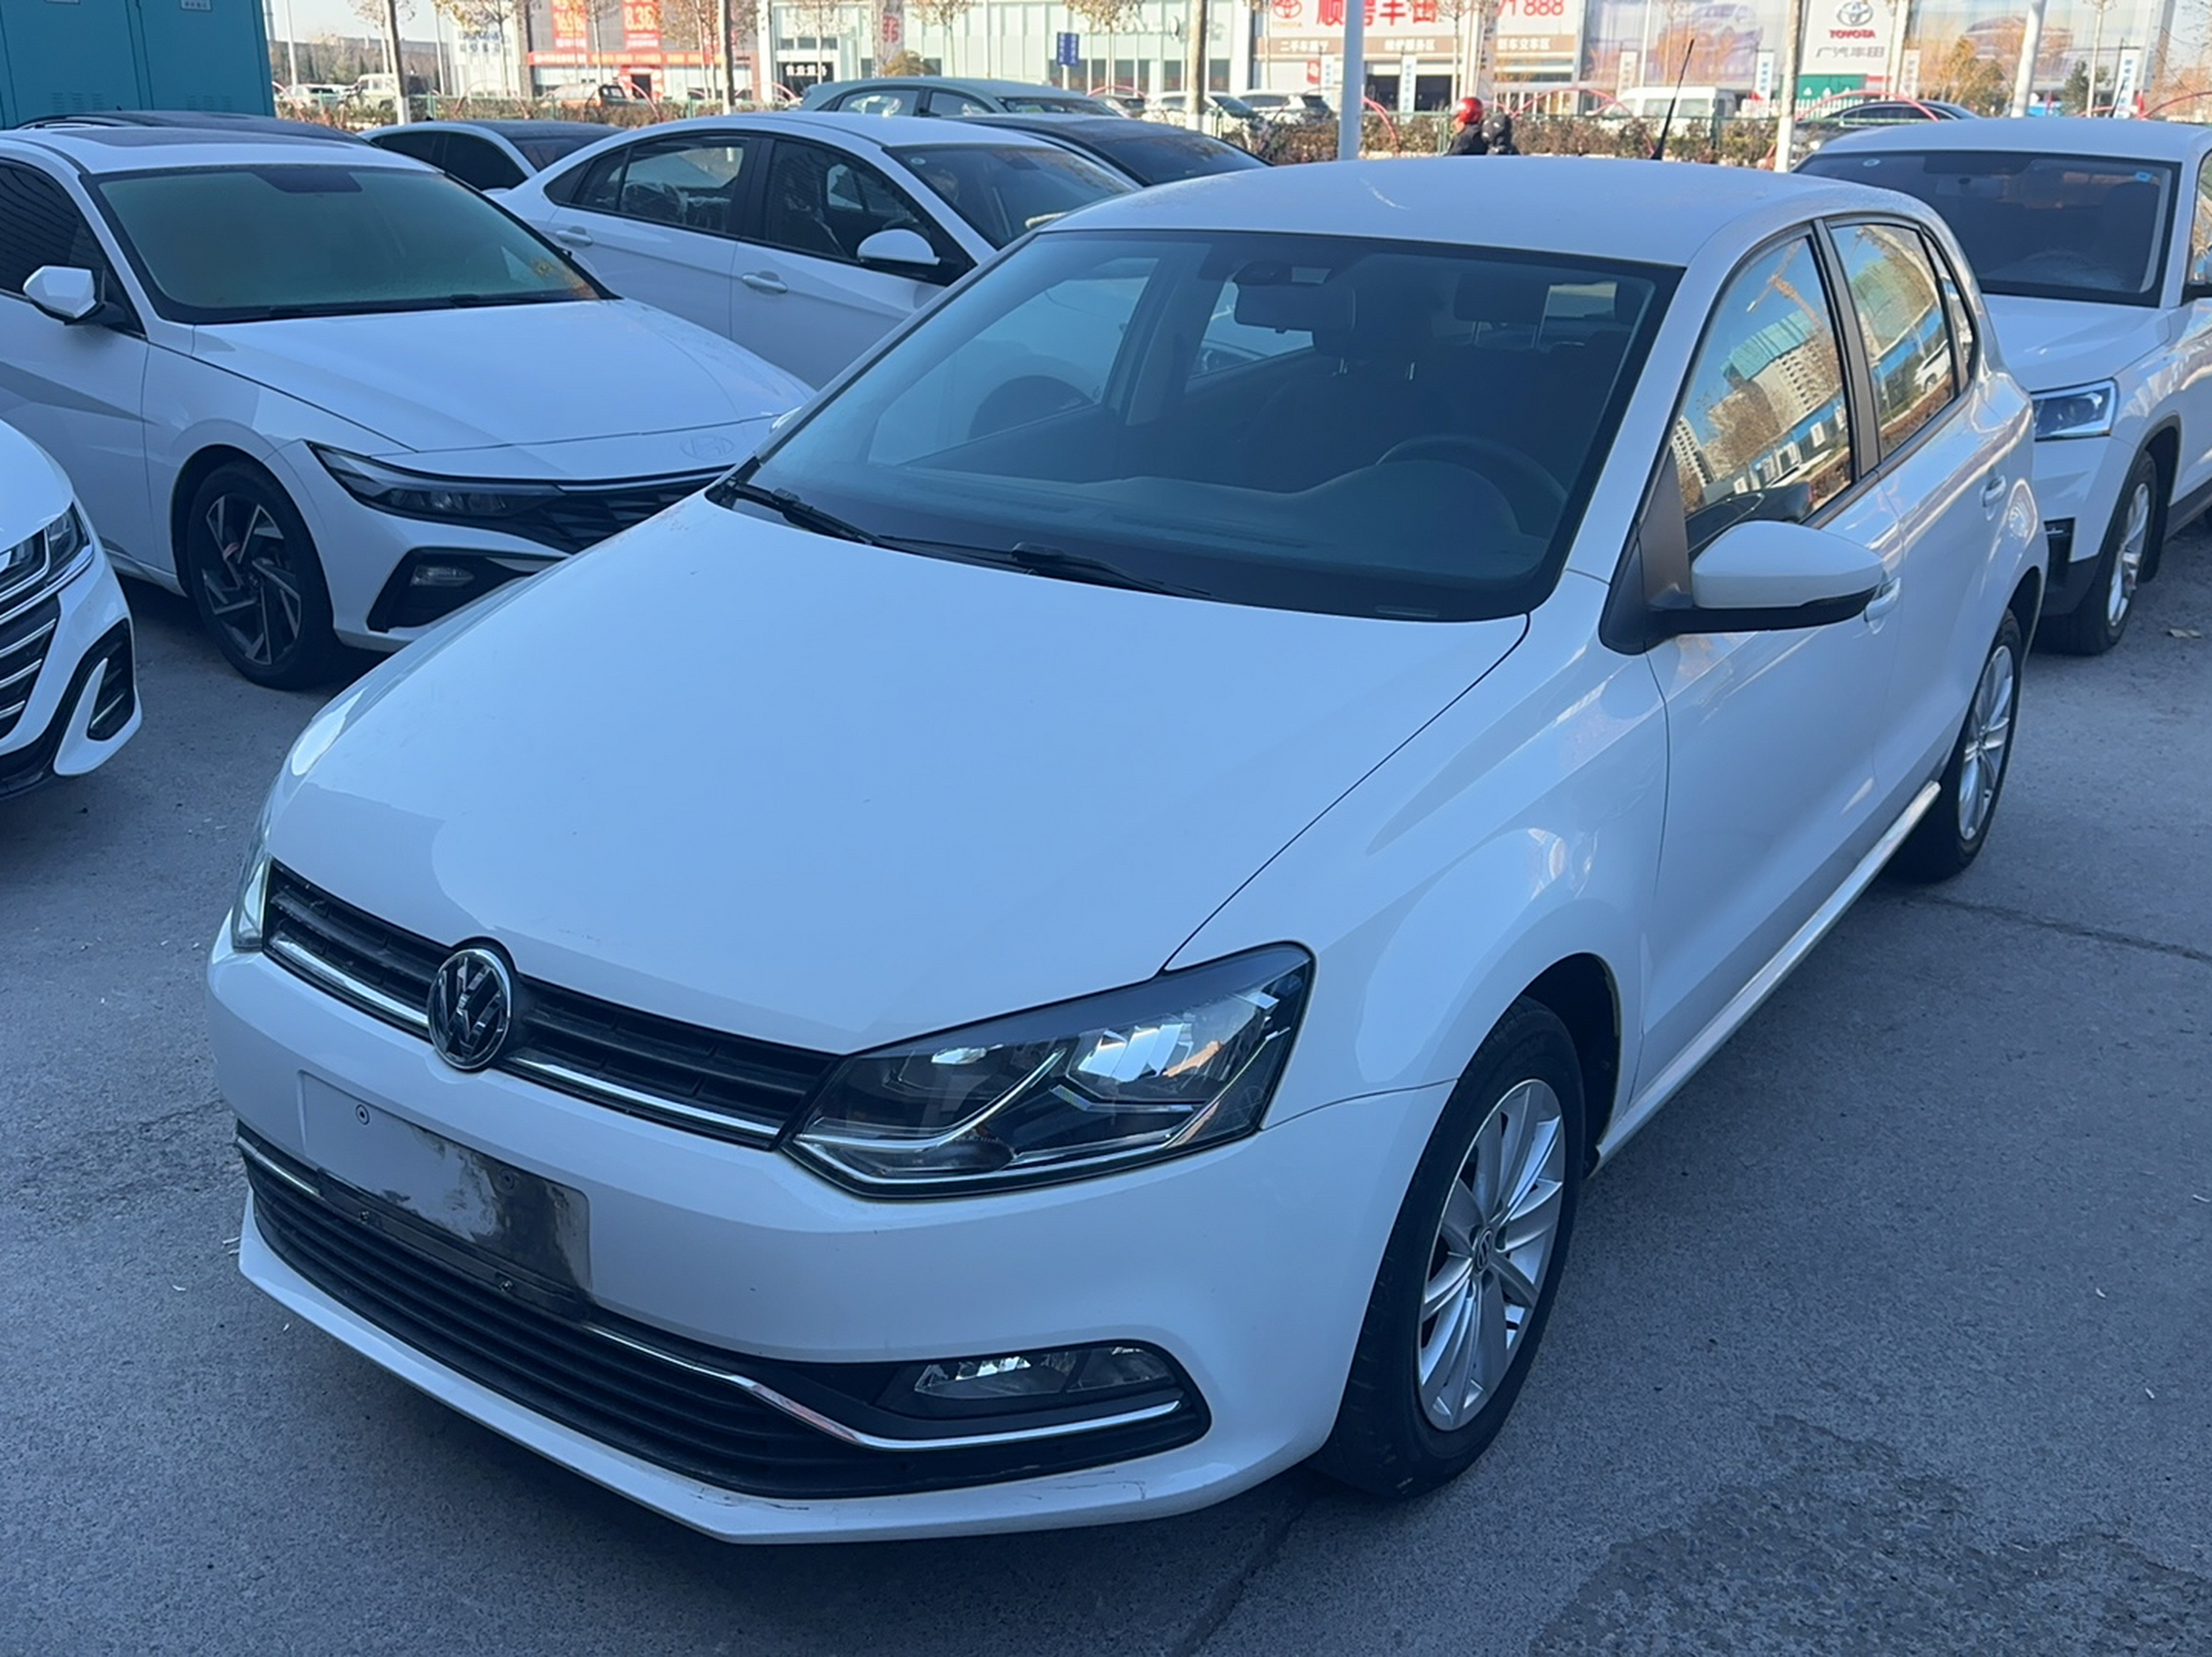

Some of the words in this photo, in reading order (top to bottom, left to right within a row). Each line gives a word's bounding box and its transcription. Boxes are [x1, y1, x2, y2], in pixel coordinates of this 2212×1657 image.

[1829, 29, 1876, 39] TOYOTA
[1816, 46, 1885, 58] 广汽丰田
